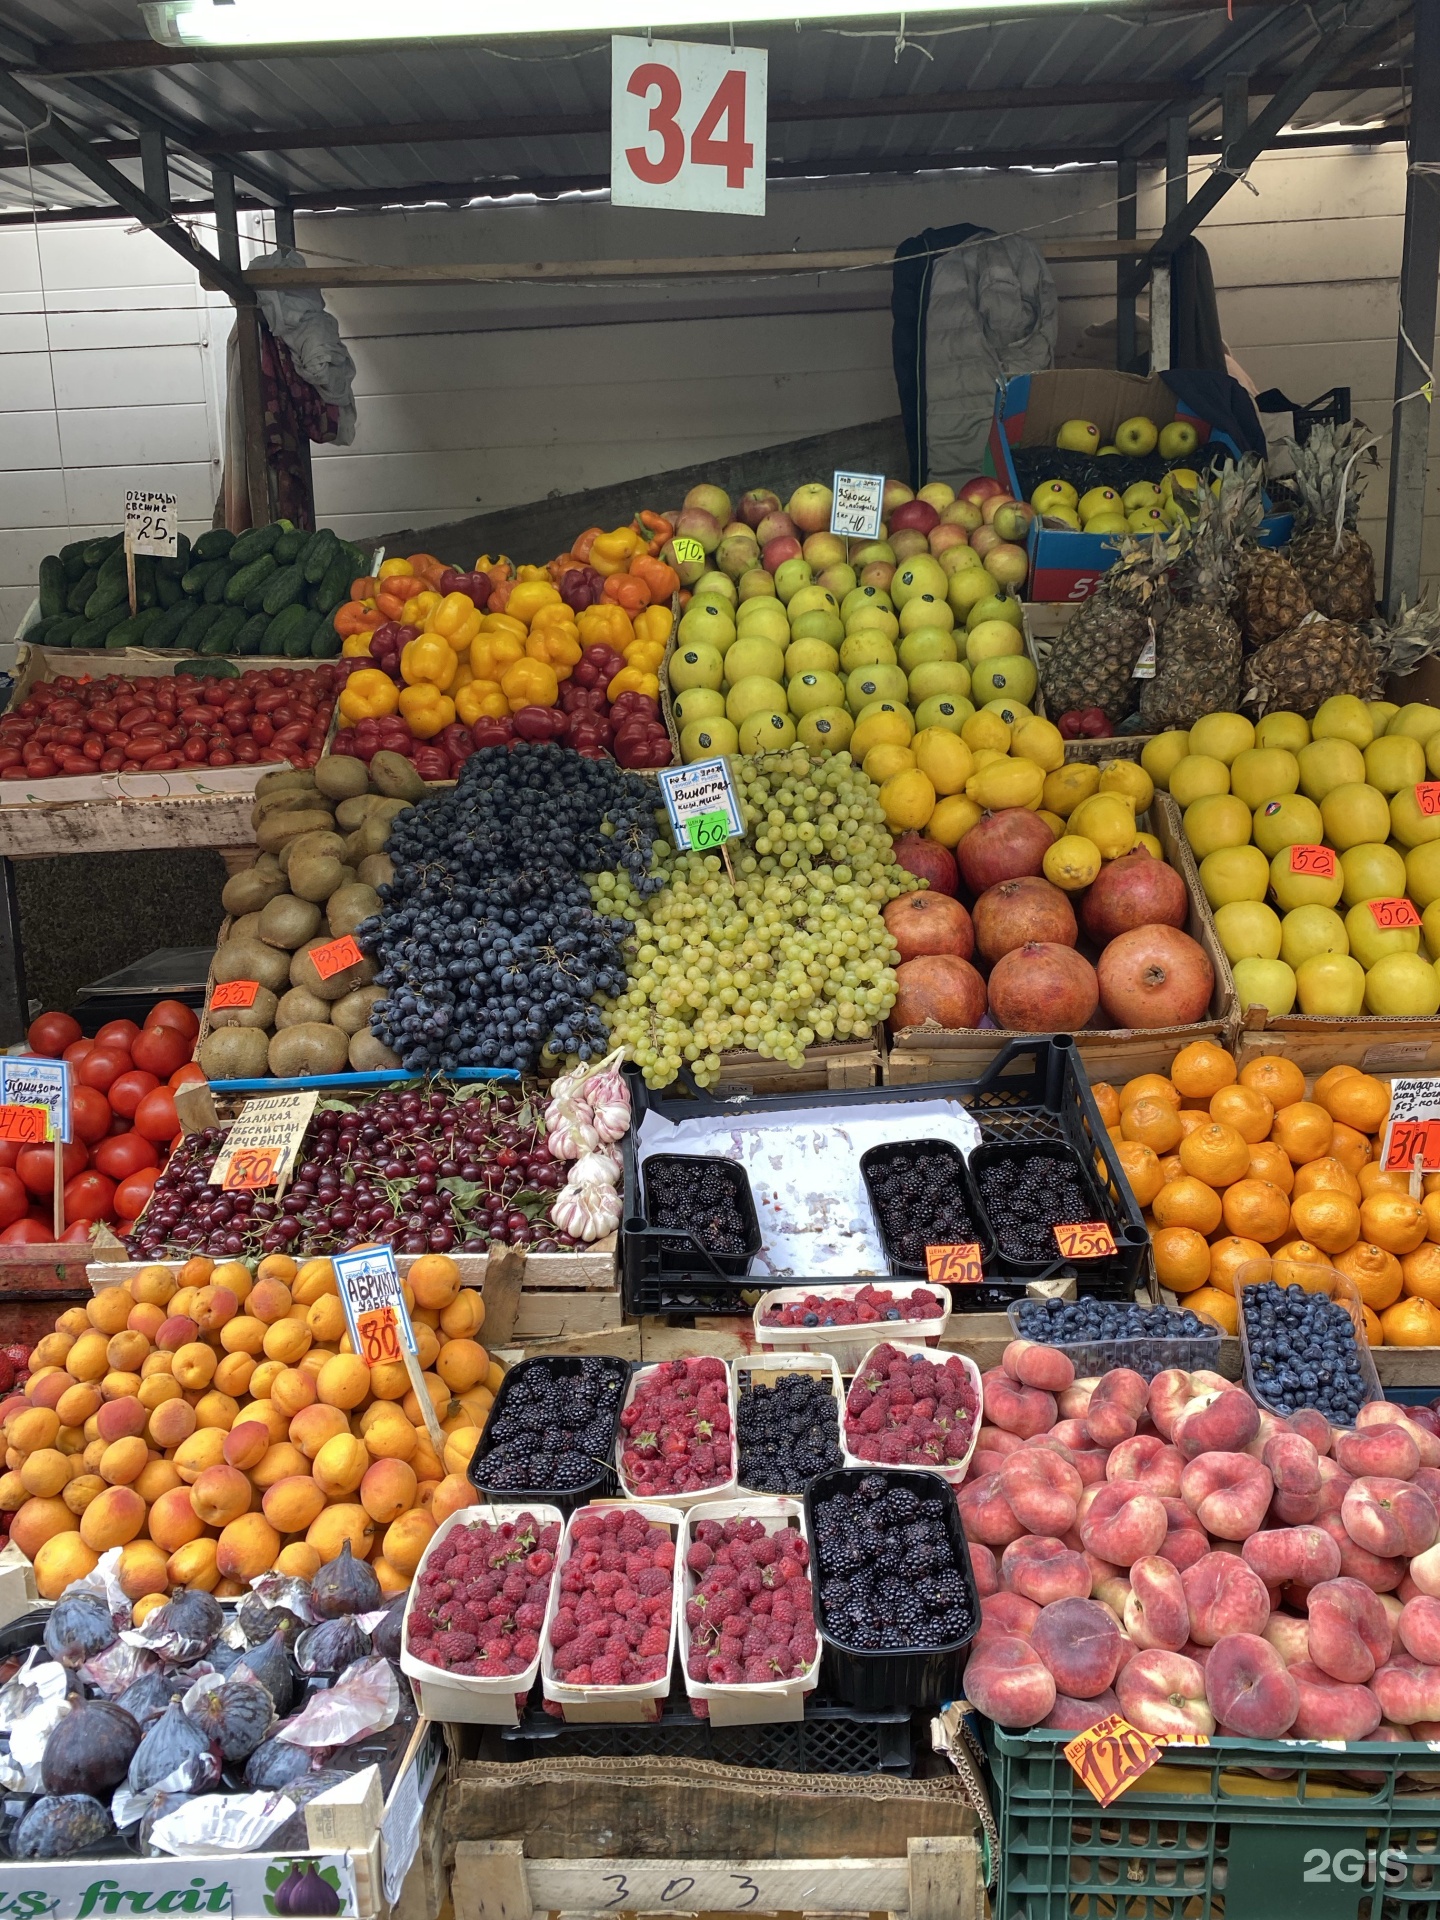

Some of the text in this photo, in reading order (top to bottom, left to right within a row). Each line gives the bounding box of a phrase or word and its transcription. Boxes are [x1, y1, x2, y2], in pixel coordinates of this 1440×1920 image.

[625, 63, 753, 189] 34
[243, 1096, 300, 1113] ВИШНЯ
[929, 1253, 982, 1282] 150
[76, 1877, 233, 1920] fruit
